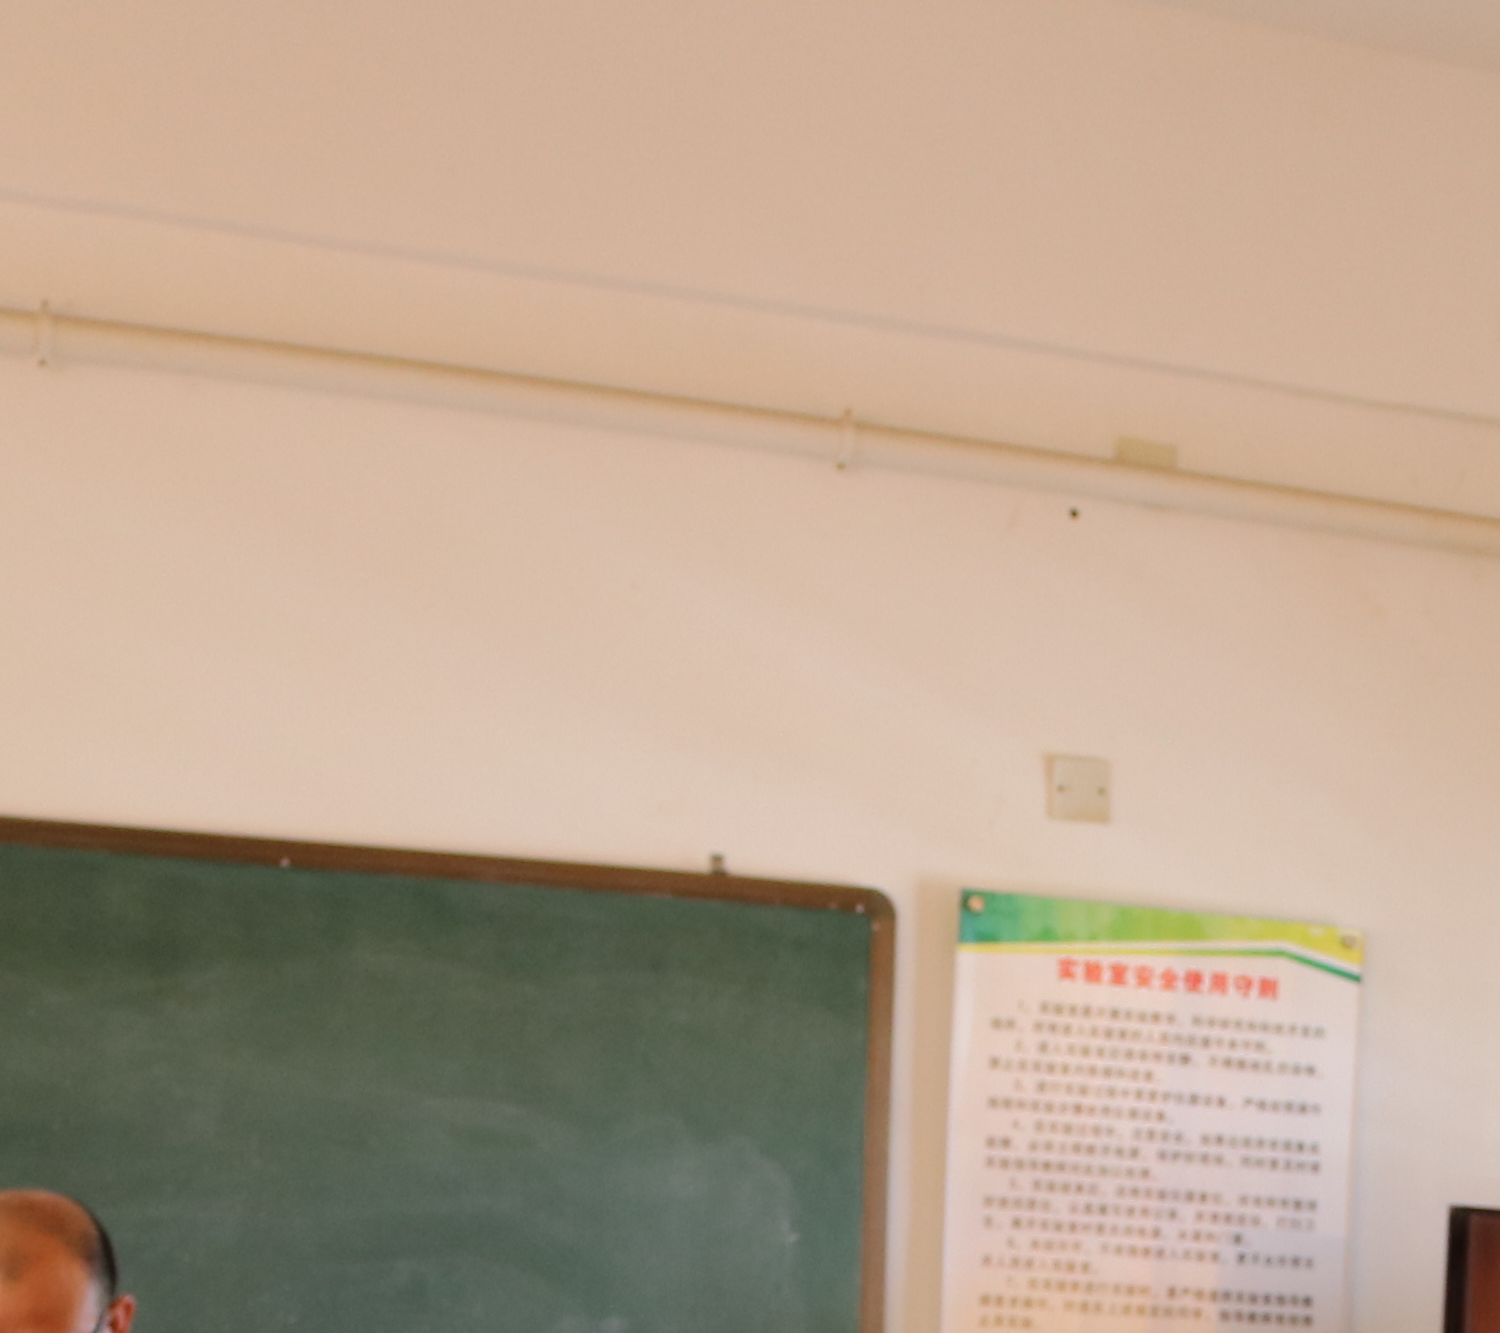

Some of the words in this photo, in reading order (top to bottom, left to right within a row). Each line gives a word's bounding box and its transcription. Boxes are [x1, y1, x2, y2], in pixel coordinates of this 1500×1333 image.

[1057, 957, 1278, 1001] 实验室安全使用守则
